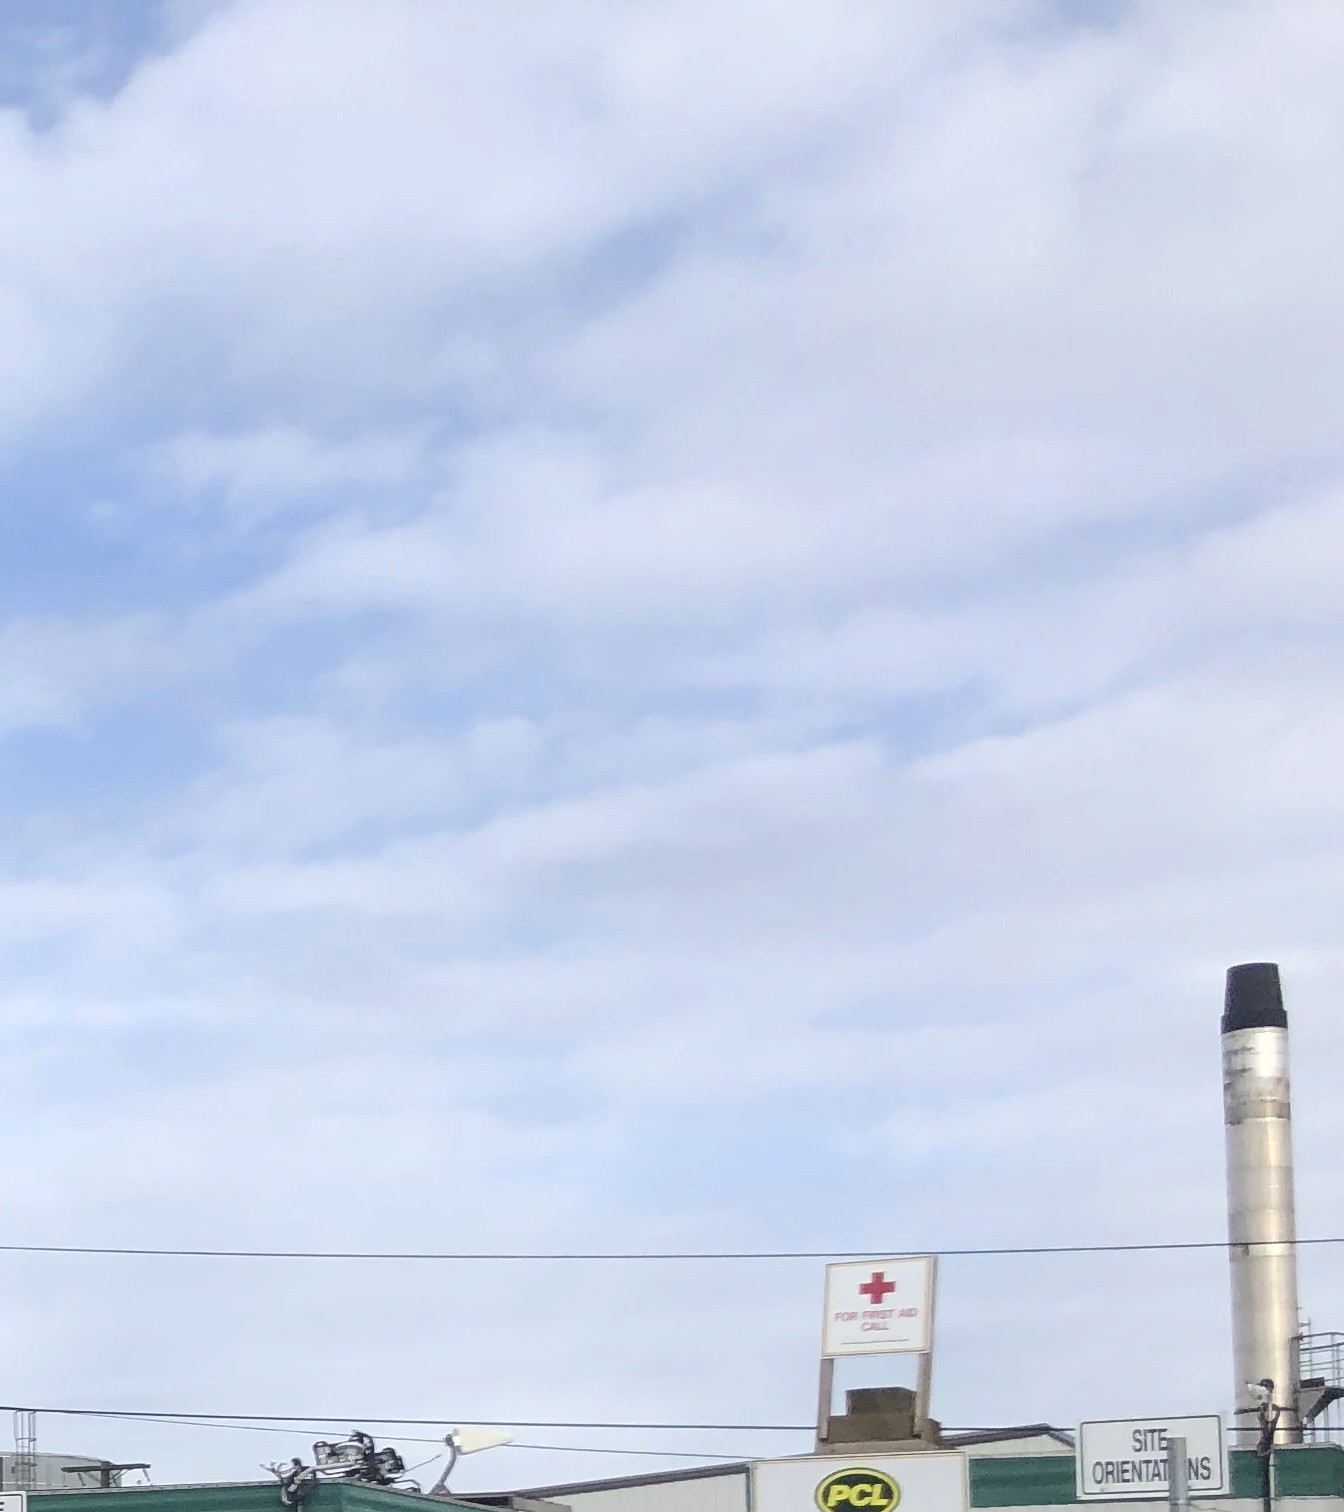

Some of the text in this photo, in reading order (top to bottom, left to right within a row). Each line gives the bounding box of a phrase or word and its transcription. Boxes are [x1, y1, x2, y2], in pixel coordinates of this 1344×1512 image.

[1132, 1428, 1169, 1452] SITE
[1092, 1457, 1211, 1484] ORIENTATNS
[827, 1483, 888, 1507] PCL
